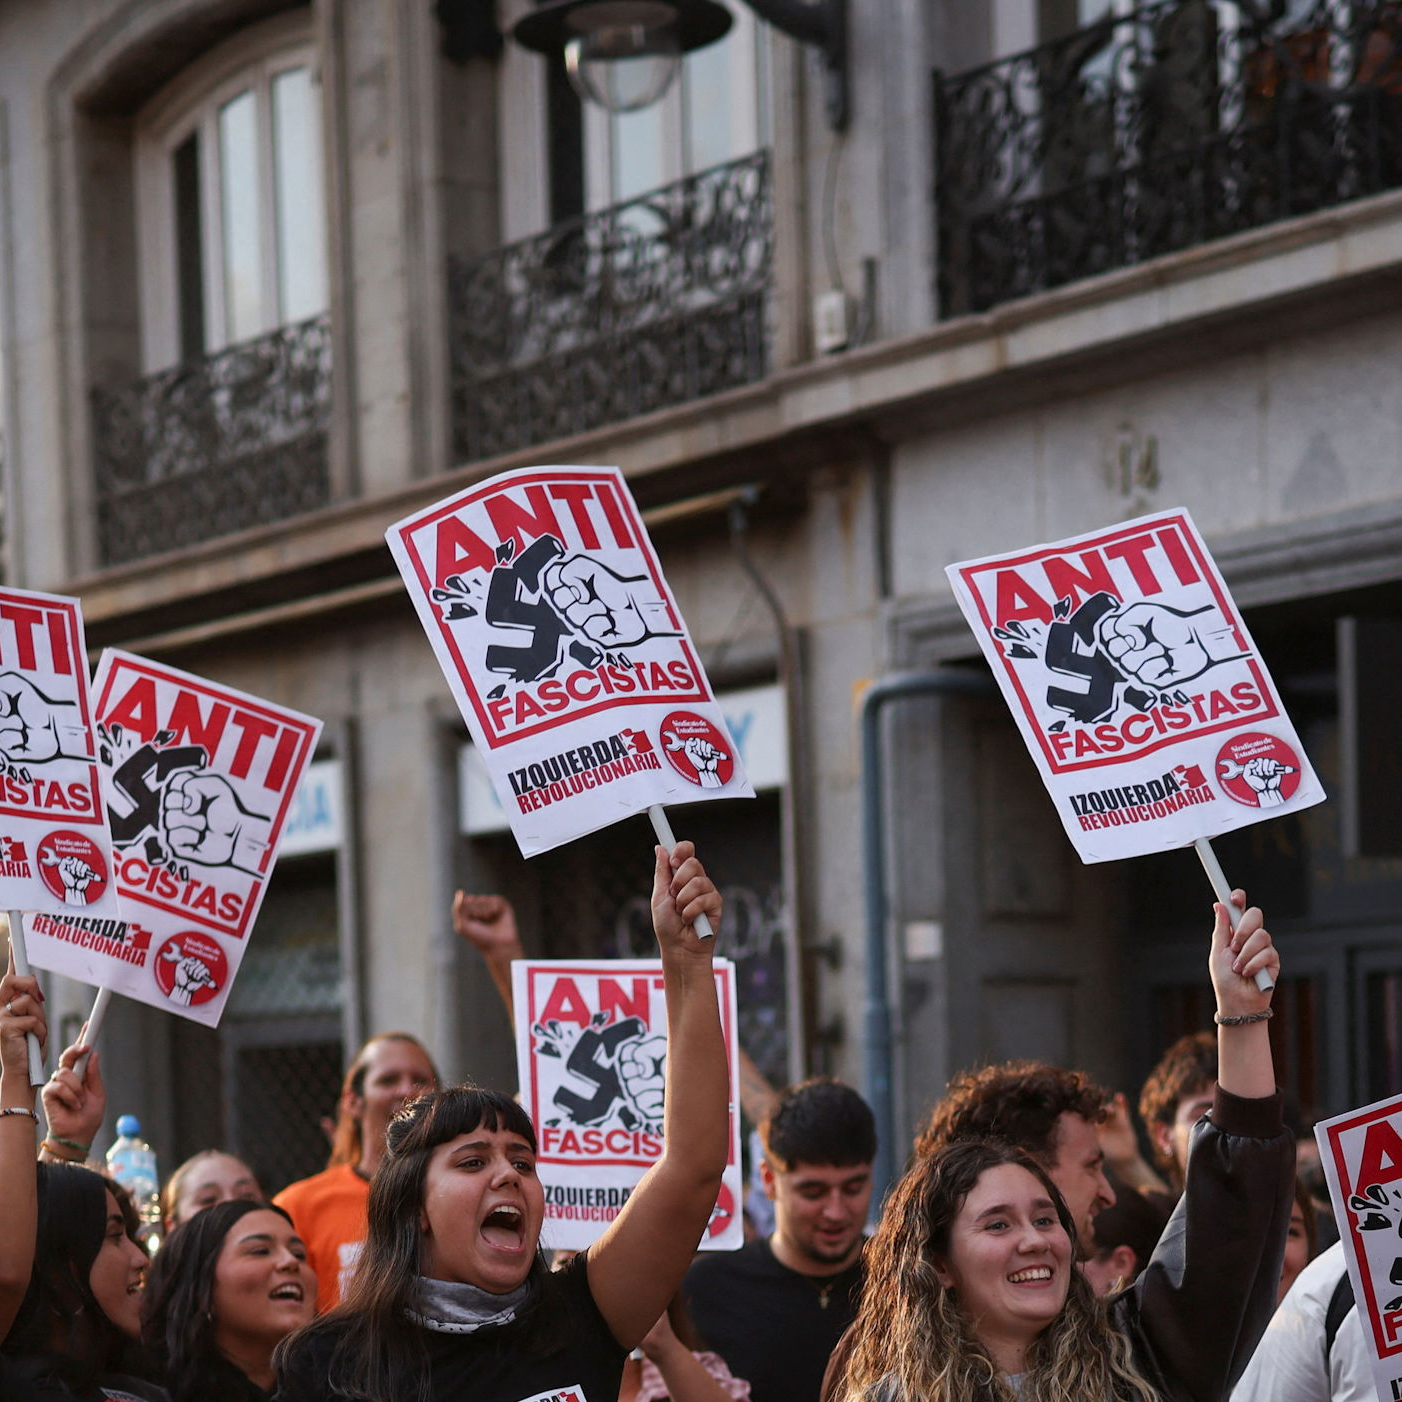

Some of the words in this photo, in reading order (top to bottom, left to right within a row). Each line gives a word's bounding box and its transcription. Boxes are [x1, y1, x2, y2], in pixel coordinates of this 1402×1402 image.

[435, 483, 635, 589] ANTI
[995, 527, 1201, 624] ANTI
[487, 660, 695, 731] FASCISTAS
[1049, 682, 1261, 760] FASCISTAS
[106, 678, 303, 792] ANTI
[508, 735, 629, 796] IZQUIERDA
[516, 752, 662, 814] REVOLUCIONARIA
[1069, 773, 1180, 816] IZQUIERDA
[1077, 785, 1216, 832] REVOLUCIONARIA
[112, 850, 242, 922] CISTAS
[32, 915, 147, 967] REVOLUCIONARIA
[540, 977, 665, 1031] AN
[542, 1128, 663, 1157] FASCIS
[545, 1185, 631, 1206] ZQUIERDA
